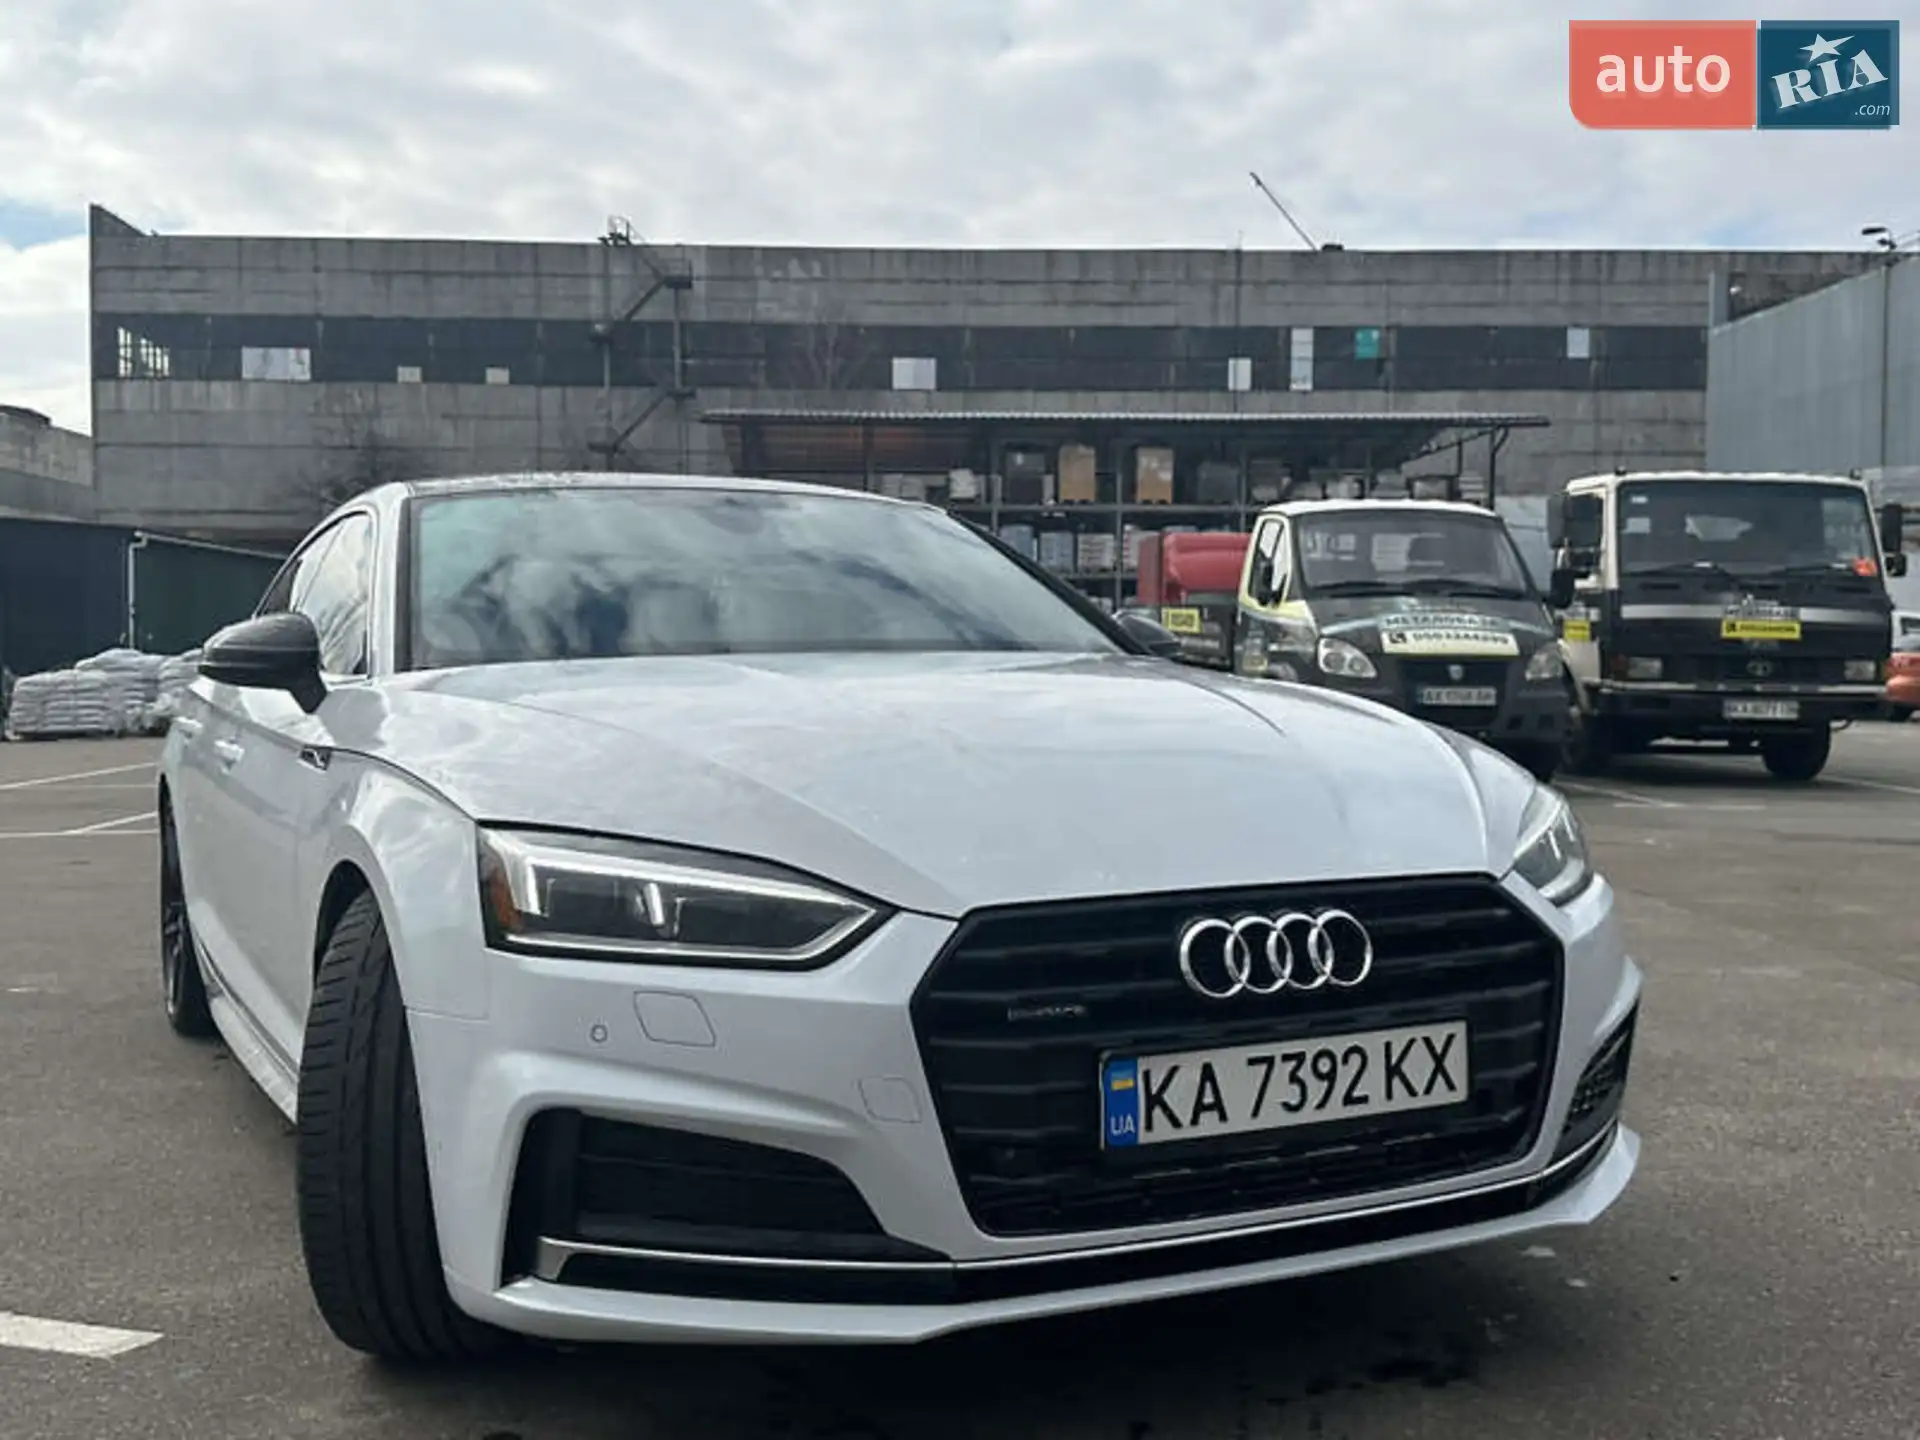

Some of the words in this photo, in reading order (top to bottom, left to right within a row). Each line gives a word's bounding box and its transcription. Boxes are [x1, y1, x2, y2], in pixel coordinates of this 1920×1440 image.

[1141, 1062, 1229, 1133] KA
[1246, 1044, 1370, 1119] 7392
[1383, 1032, 1457, 1102] KX
[1110, 1113, 1136, 1136] UA
